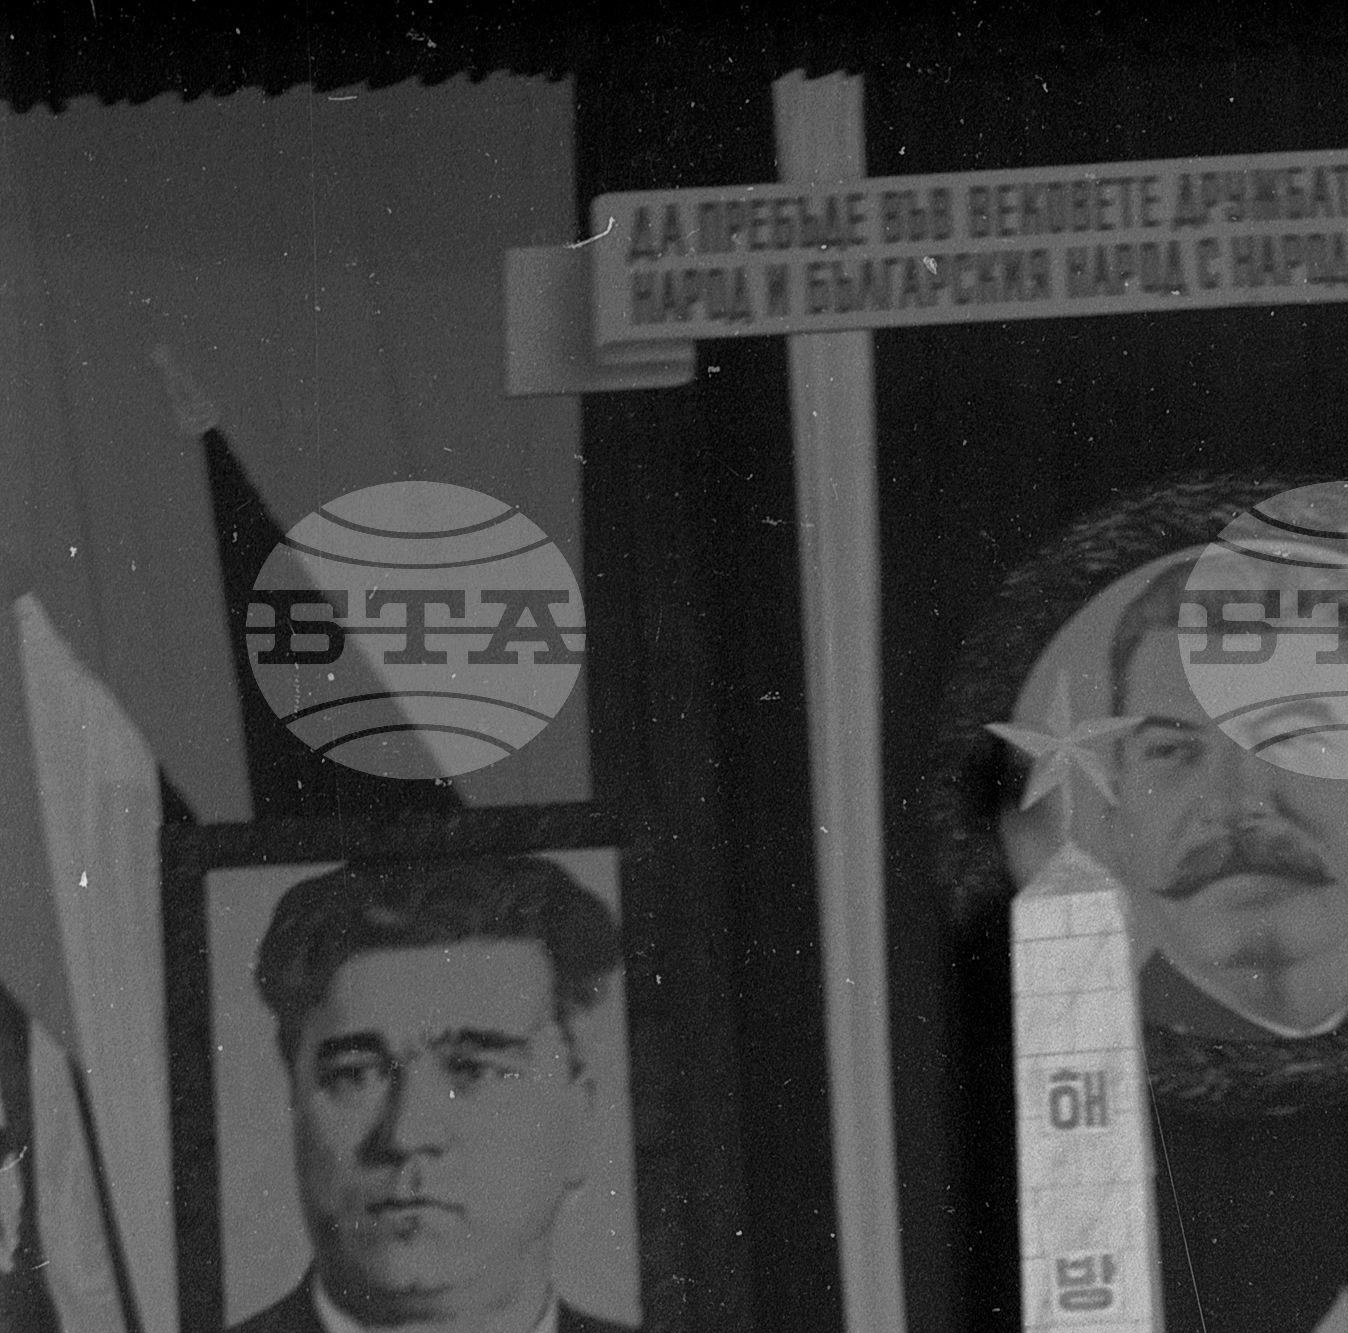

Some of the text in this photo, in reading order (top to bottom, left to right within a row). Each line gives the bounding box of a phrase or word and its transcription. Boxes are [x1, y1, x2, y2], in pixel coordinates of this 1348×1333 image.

[628, 203, 686, 263] ДА
[698, 192, 866, 257] ПРЕБЪДЕ
[883, 187, 952, 243] ВЪВ
[970, 176, 1159, 239] ВЕКОВЕТЕ
[633, 265, 752, 328] НАРОД
[766, 262, 790, 316] И
[806, 248, 1050, 315] БЪЛГАРСКИЯ
[1067, 239, 1189, 301] НАРОД
[1197, 238, 1219, 290] С
